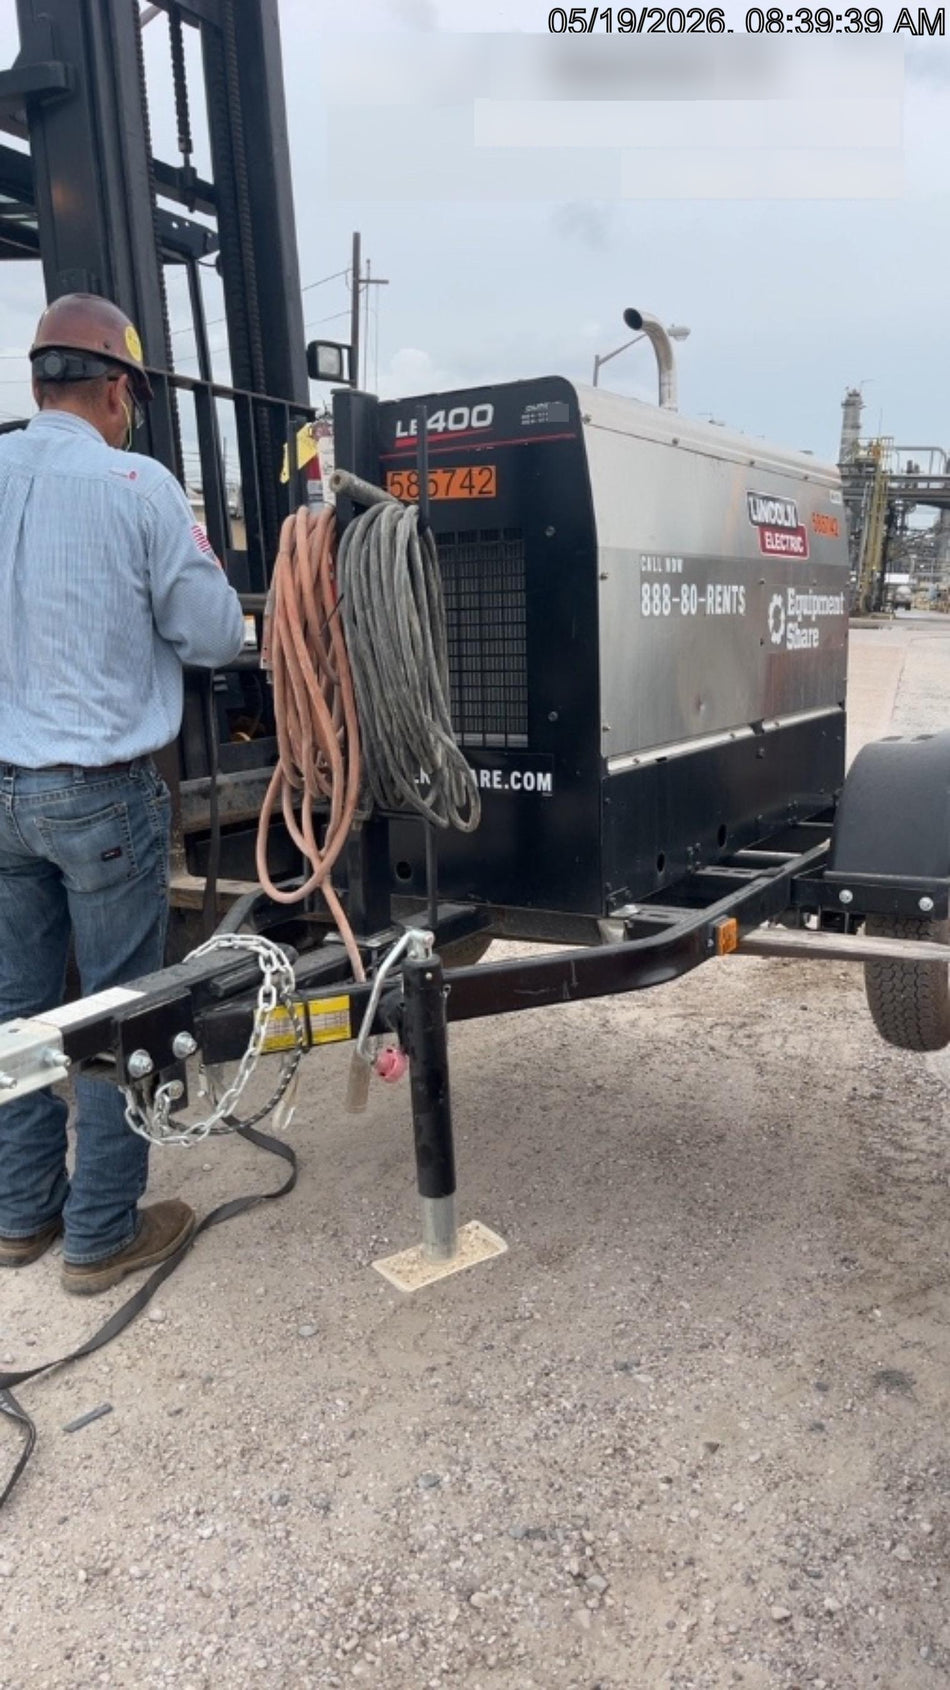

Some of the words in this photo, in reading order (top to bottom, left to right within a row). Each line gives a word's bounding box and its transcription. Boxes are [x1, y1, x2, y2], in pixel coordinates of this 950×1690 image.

[390, 466, 494, 498] 585742
[748, 496, 797, 529] LINCOLN
[763, 531, 805, 553] ELECTRIC
[641, 555, 663, 573] CALL
[641, 582, 747, 617] 888-80-RENTS
[786, 587, 845, 622] Equipment
[786, 622, 820, 650] Share
[469, 768, 553, 792] ARE.COM
